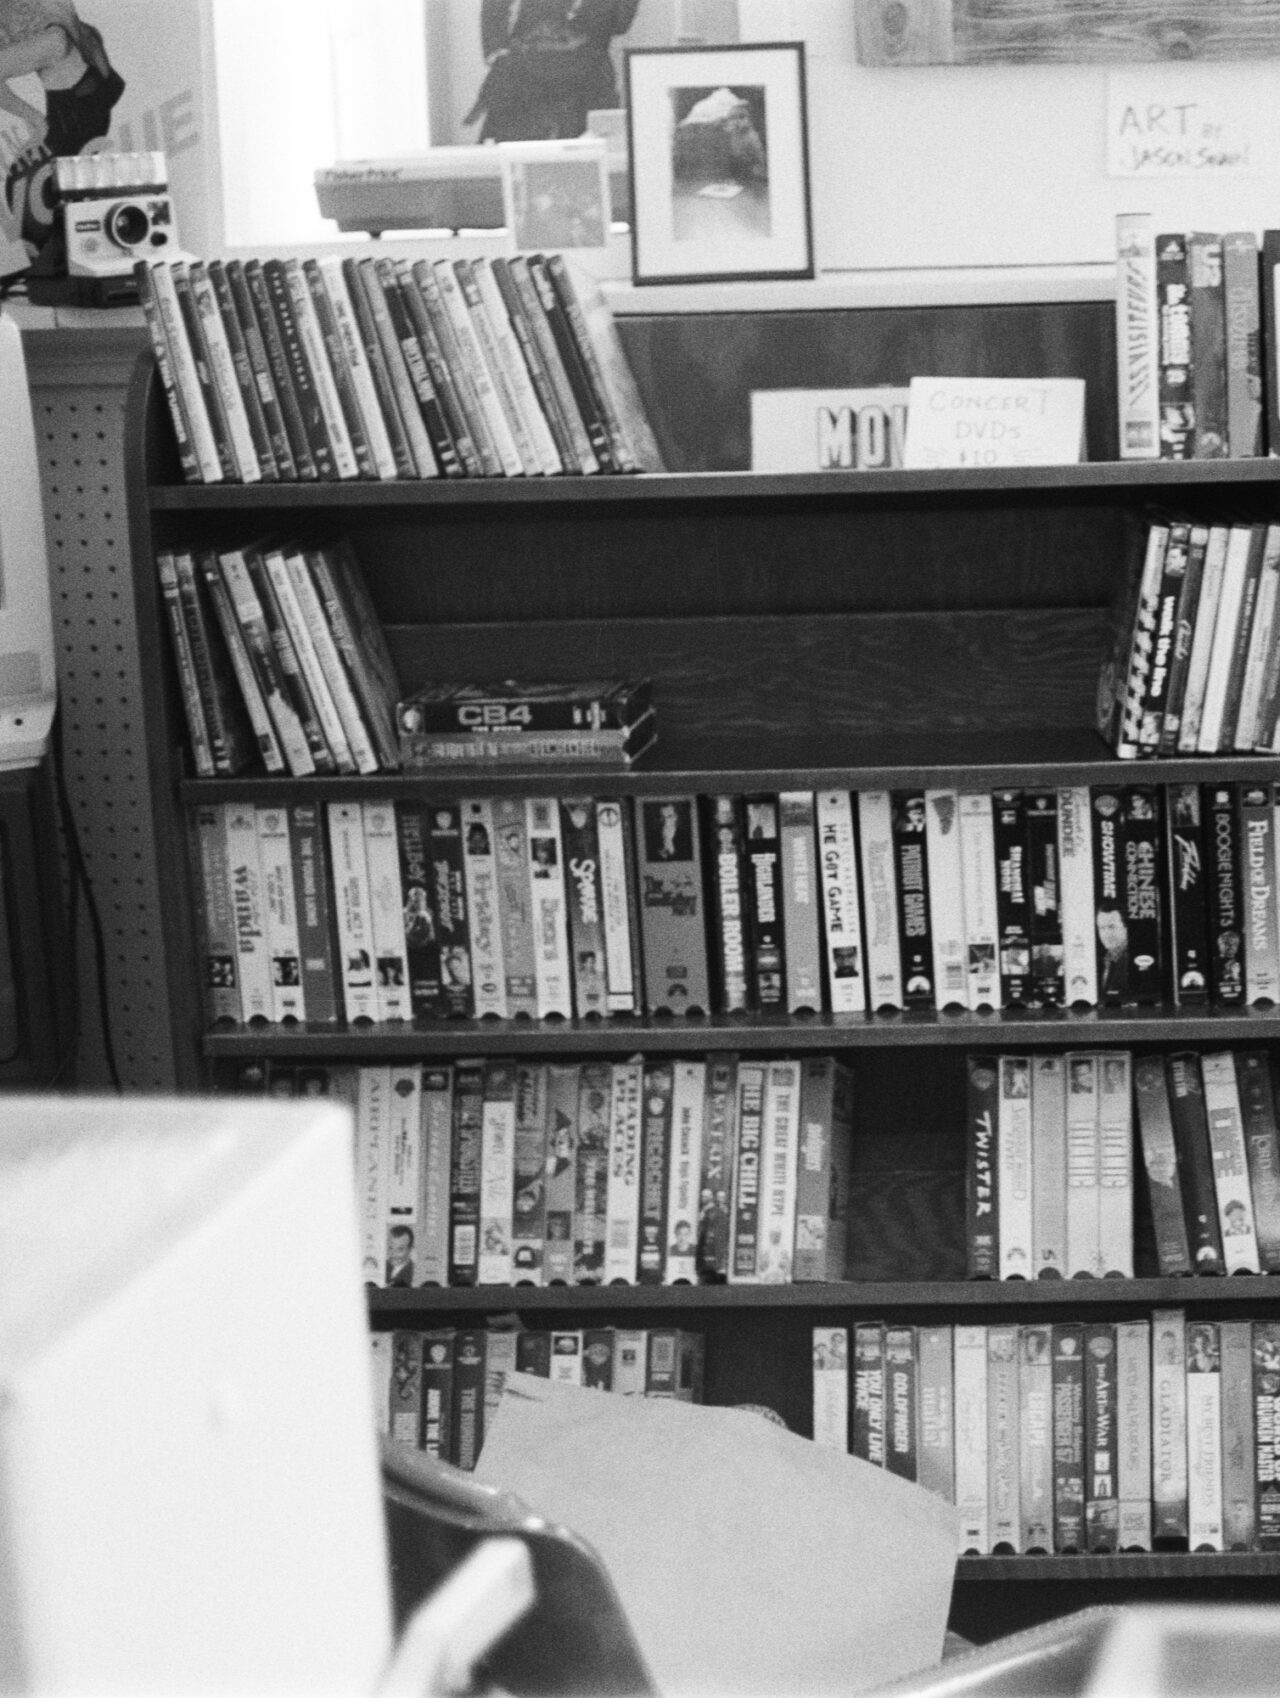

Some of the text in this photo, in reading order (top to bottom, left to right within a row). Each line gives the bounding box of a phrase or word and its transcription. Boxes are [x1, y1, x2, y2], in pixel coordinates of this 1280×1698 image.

[1118, 104, 1198, 137] ART
[929, 389, 1048, 415] CONCERT
[457, 704, 533, 726] CB4
[402, 814, 426, 883] HELLBOY
[823, 823, 838, 845] HE
[1060, 788, 1076, 859] DUNDEE
[1247, 819, 1270, 867] FIELD
[900, 844, 927, 937] PATRIOT GAMES
[999, 859, 1011, 892] NOON
[1008, 845, 1025, 904] SHANGHAI
[1101, 819, 1117, 899] SHOWTIME
[1125, 840, 1140, 919] CONNECTION
[1138, 840, 1157, 919] CHINESE
[1215, 813, 1234, 927] BOOGIE NIGHTS
[233, 865, 263, 954] wanda
[718, 852, 744, 972] BOILER ROOM
[1250, 885, 1272, 952] DREAMS
[740, 1114, 760, 1149] BIG
[975, 1110, 992, 1218] TWISTER
[738, 1151, 759, 1210] CHILL
[855, 1369, 869, 1411] TWICE
[868, 1369, 883, 1464] YOU ONLY LIVE
[893, 1371, 910, 1453] GOLDFINGER
[1096, 1378, 1111, 1405] ART
[1096, 1414, 1111, 1447] WAR
[1158, 1379, 1173, 1483] GLADIATOR
[1256, 1395, 1274, 1483] DRUNKEN MASTER
